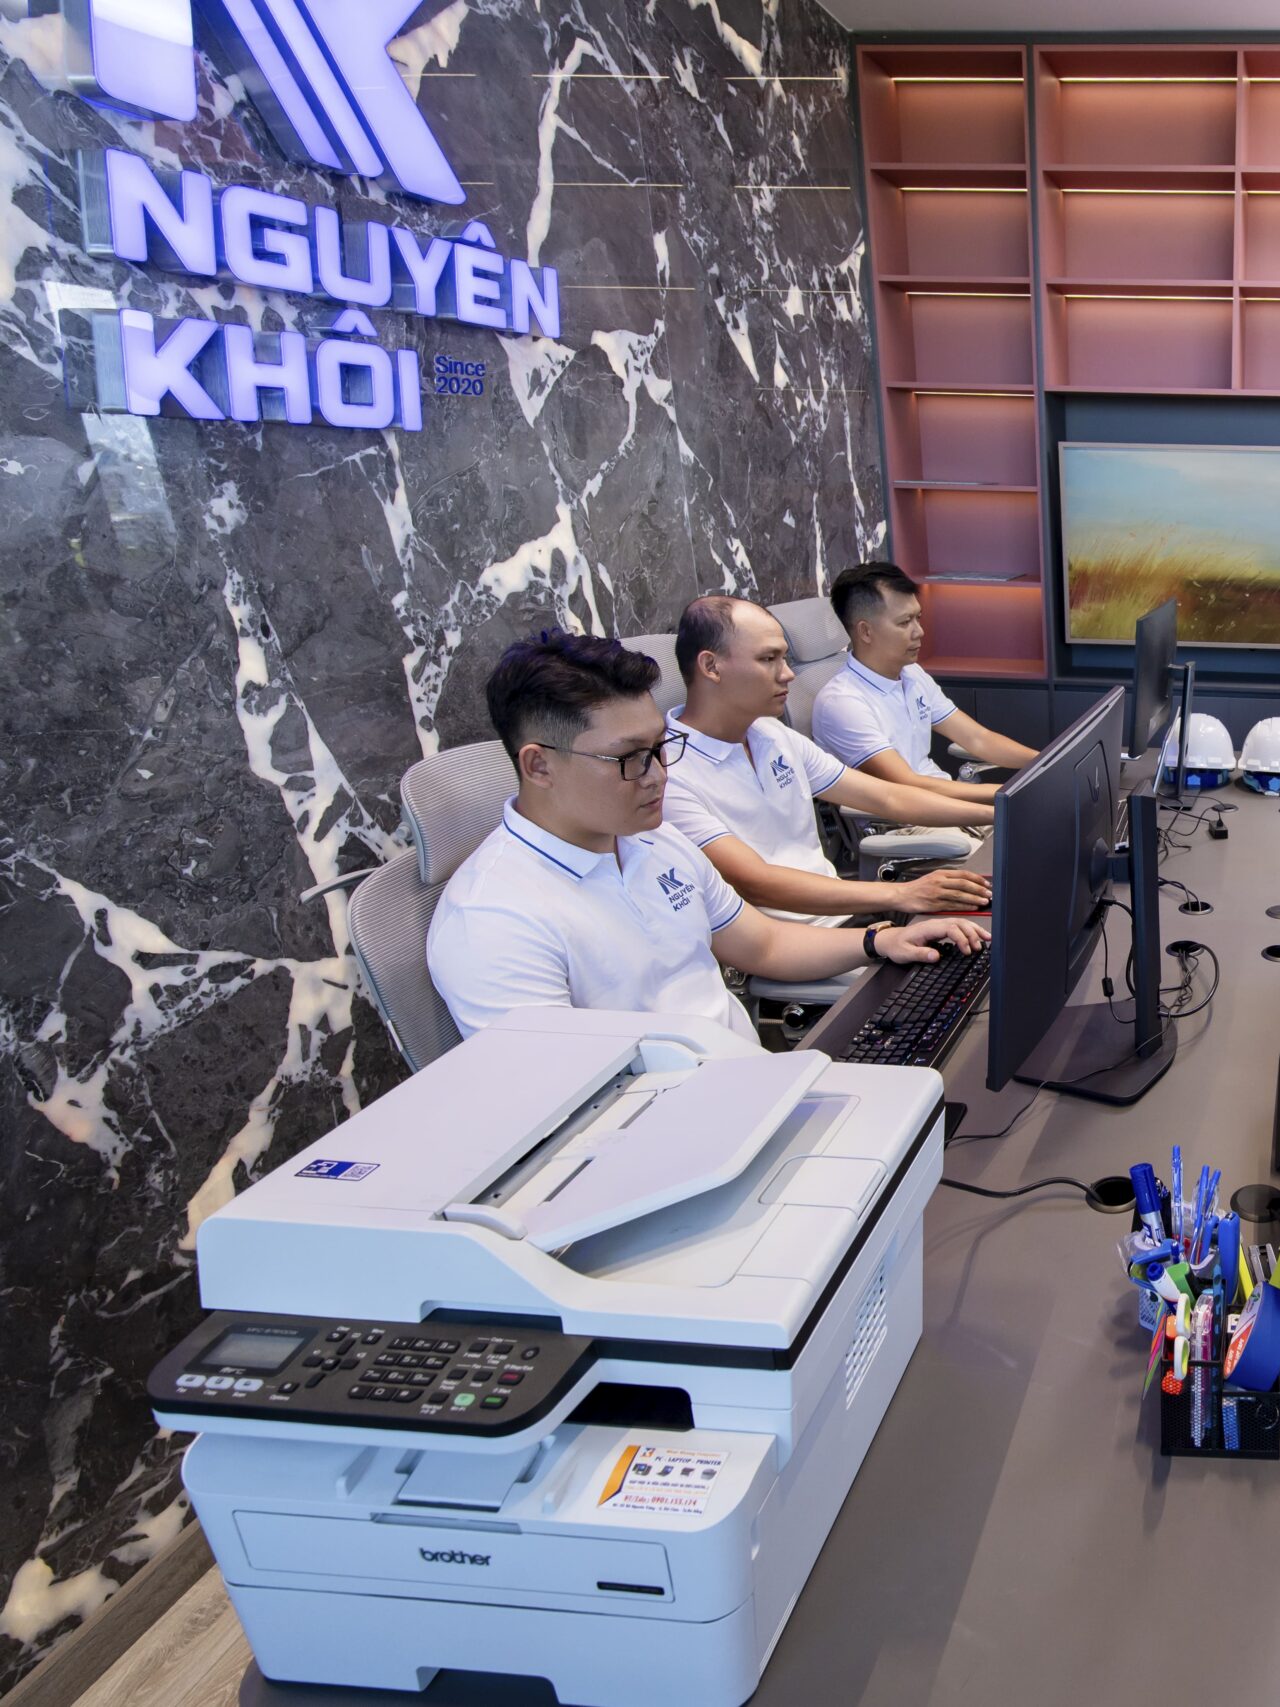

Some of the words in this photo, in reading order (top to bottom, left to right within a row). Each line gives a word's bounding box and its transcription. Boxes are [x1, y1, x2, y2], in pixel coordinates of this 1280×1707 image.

[106, 148, 560, 338] NGUYÊN
[119, 308, 423, 431] KHÔI
[435, 355, 486, 377] Since
[436, 376, 484, 396] 2020
[776, 767, 794, 783] NGUYÊ
[668, 883, 695, 903] NGUYÊN
[672, 897, 691, 911] KHÔI
[419, 1547, 491, 1566] brother
